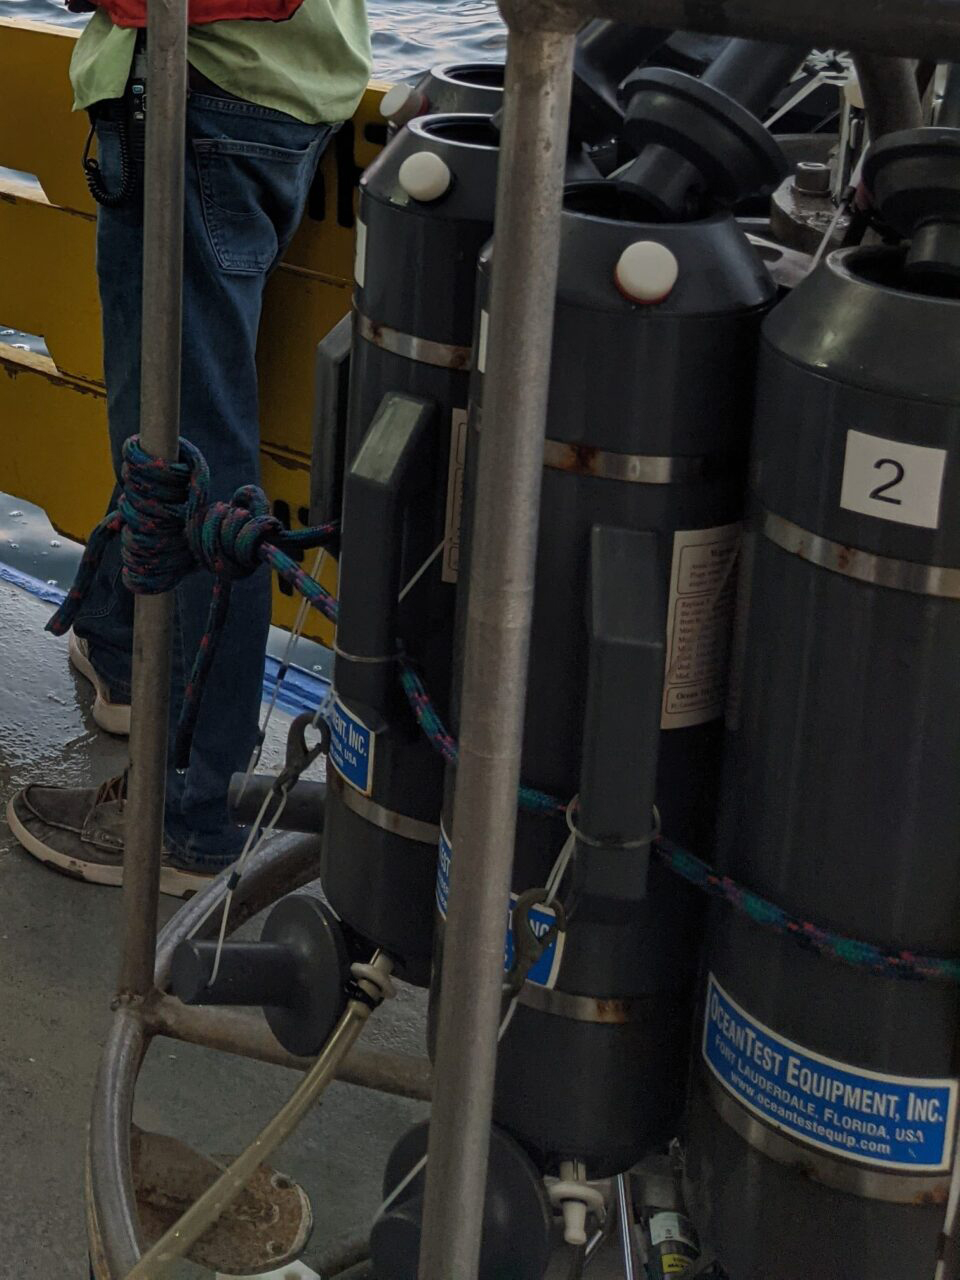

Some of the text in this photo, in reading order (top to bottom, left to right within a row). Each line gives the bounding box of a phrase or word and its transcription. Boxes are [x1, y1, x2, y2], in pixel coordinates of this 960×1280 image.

[869, 458, 904, 506] 2
[714, 1033, 736, 1062] FORT
[895, 1127, 924, 1143] USA
[730, 1071, 890, 1154] www.oceantestequip.com
[906, 1091, 944, 1123] INC.
